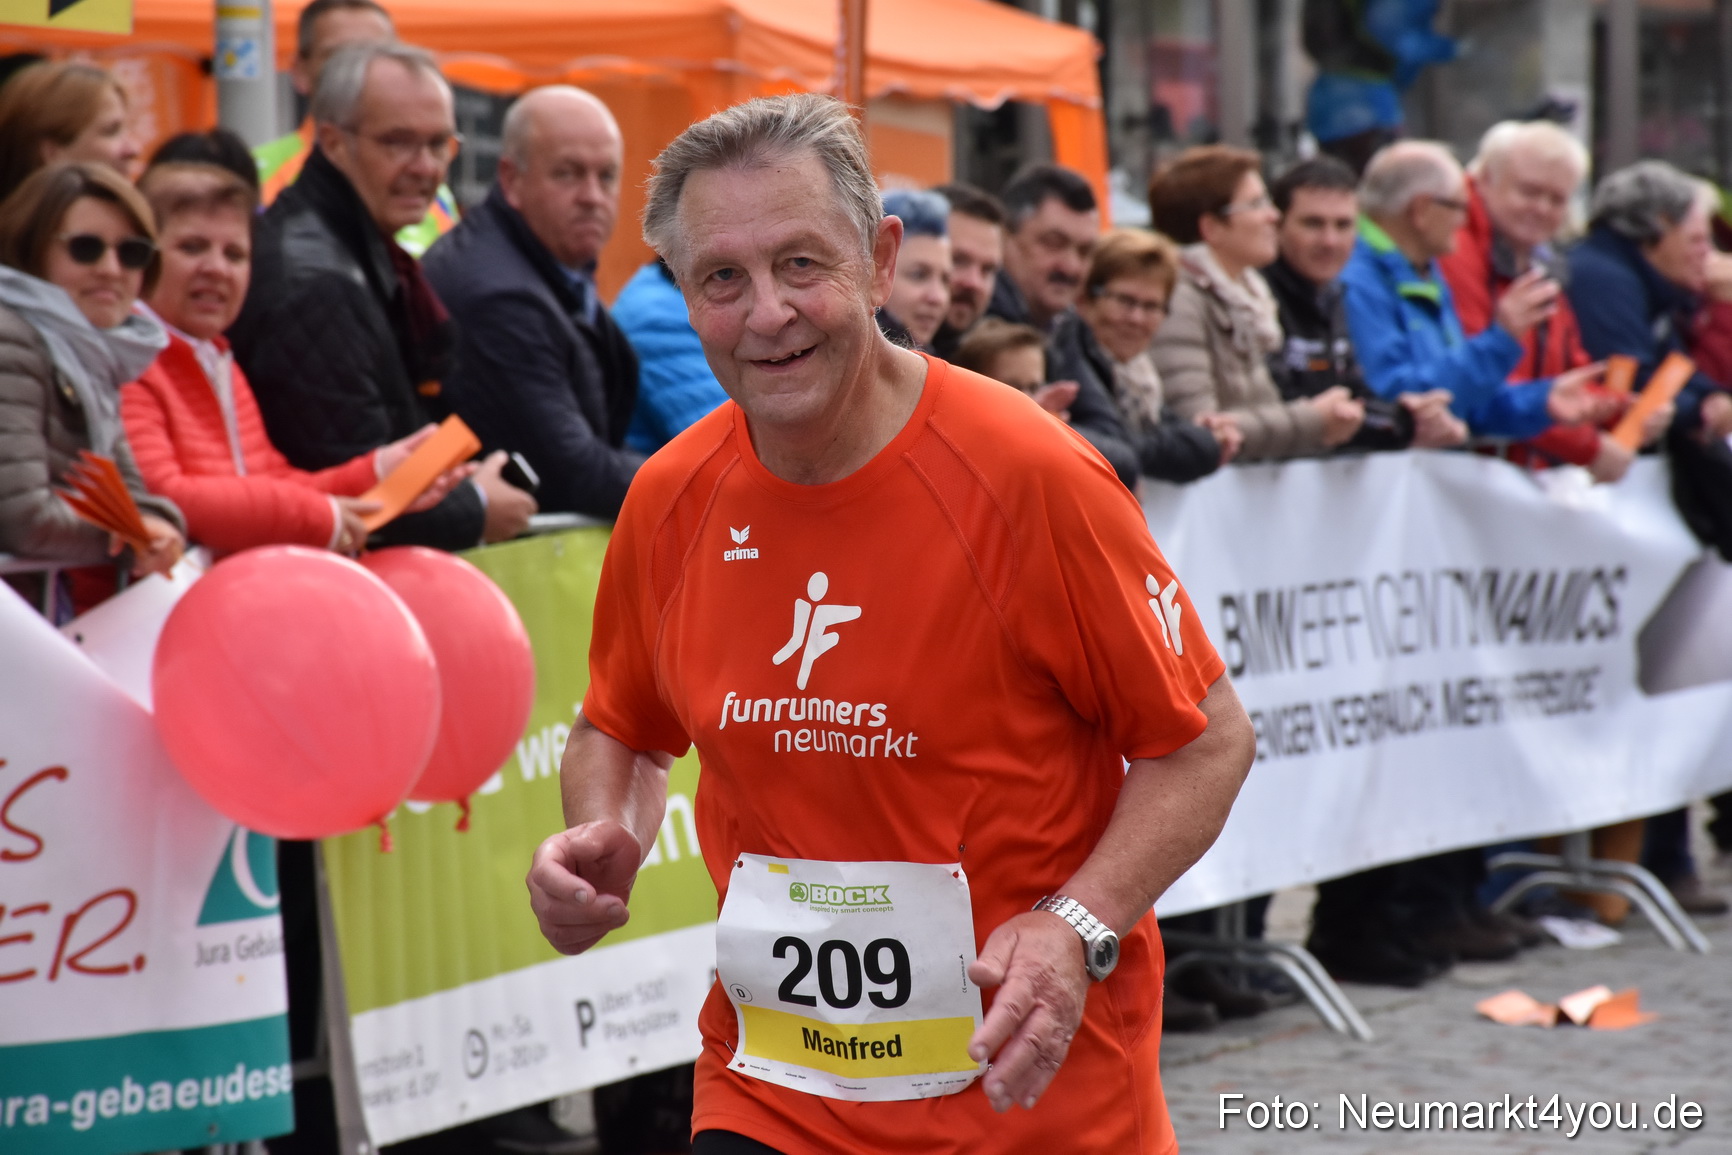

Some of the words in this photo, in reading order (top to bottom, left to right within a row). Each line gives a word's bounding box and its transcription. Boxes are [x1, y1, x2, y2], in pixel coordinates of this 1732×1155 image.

[723, 546, 759, 562] erima
[718, 691, 888, 731] funrunners
[774, 728, 919, 758] neumarkt
[809, 905, 831, 913] inspired
[862, 905, 894, 913] concepts
[810, 884, 893, 906] BOCK
[772, 936, 911, 1009] 209
[735, 988, 746, 998] D
[802, 1027, 902, 1060] Manfred
[0, 1062, 293, 1131] ra-gebaeudese
